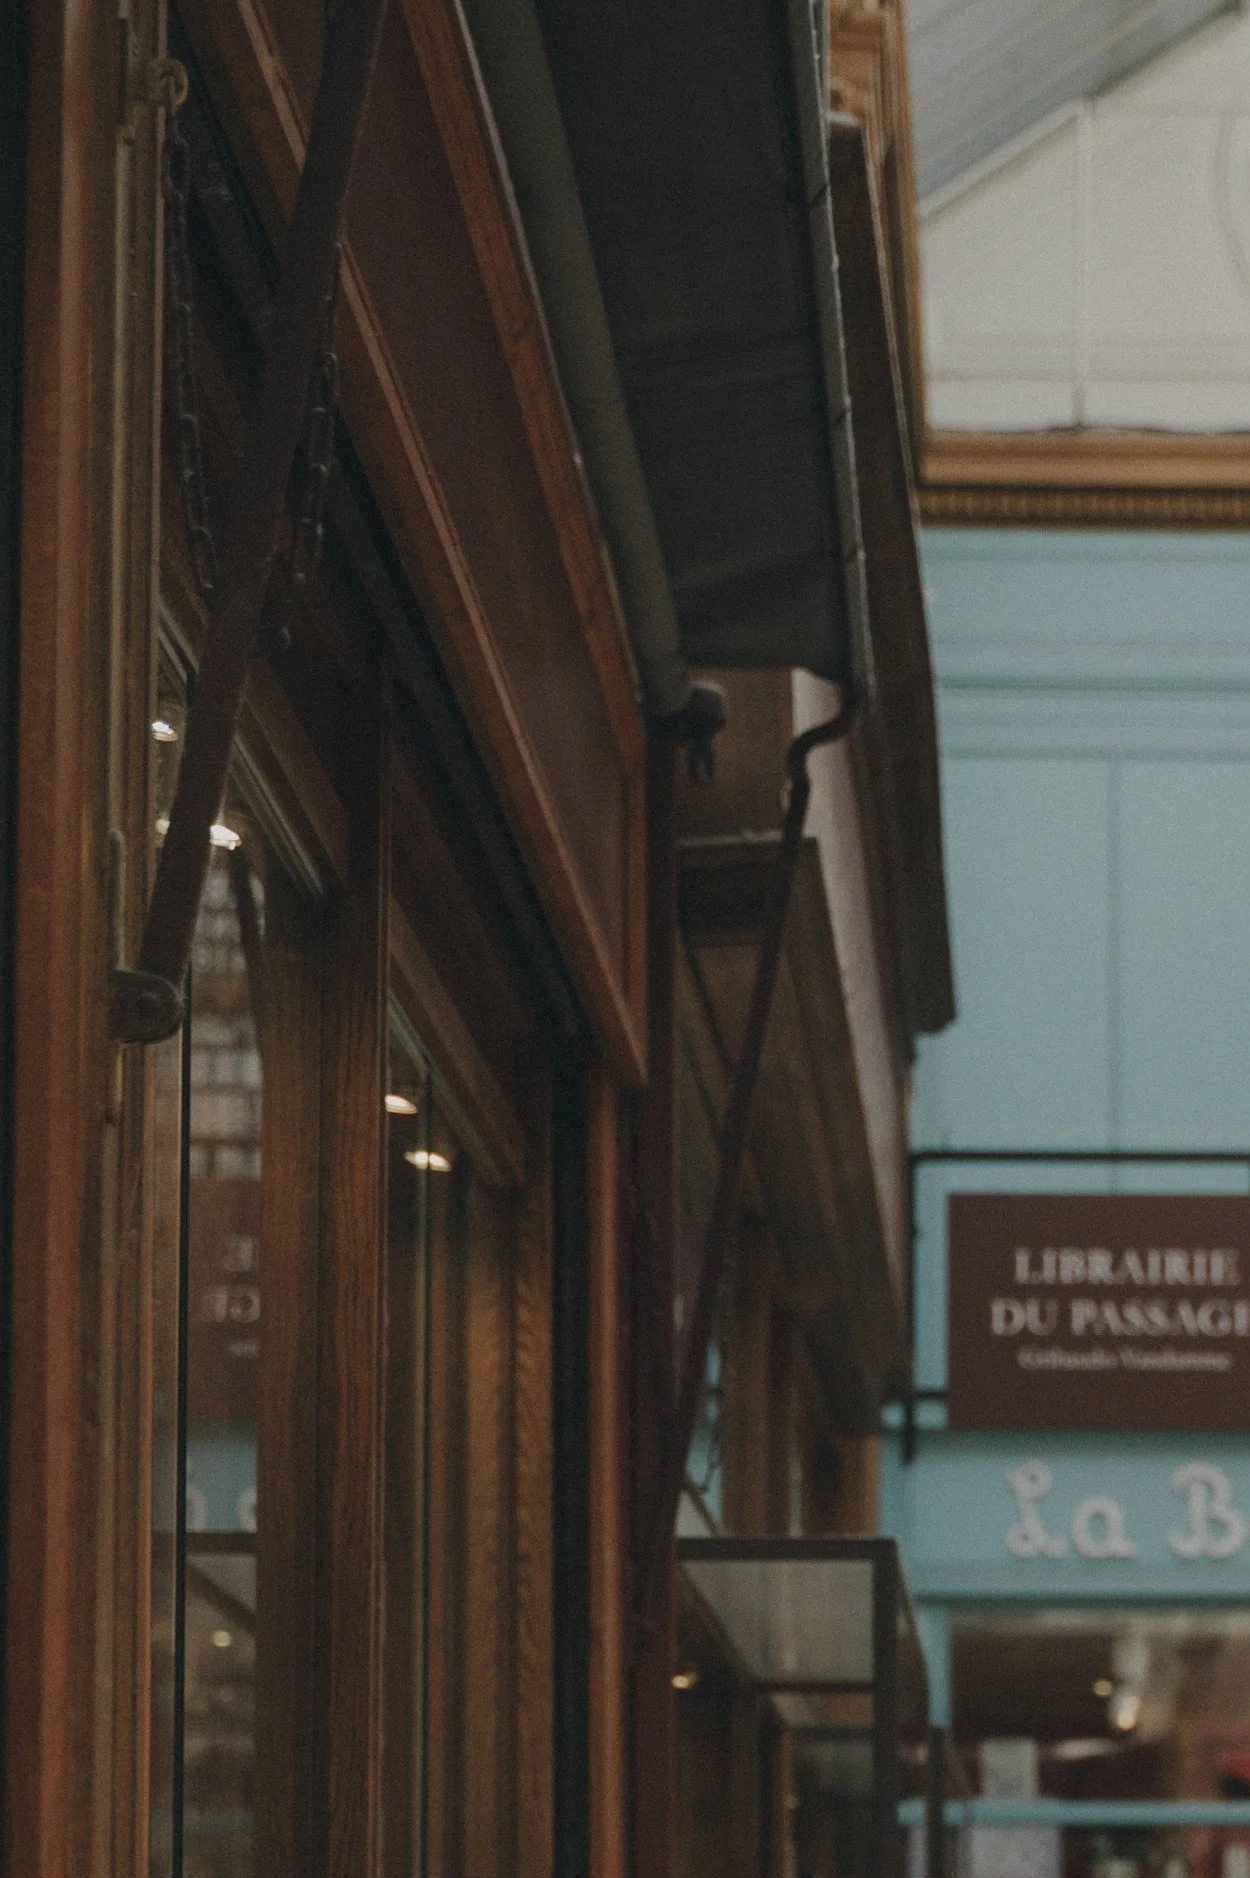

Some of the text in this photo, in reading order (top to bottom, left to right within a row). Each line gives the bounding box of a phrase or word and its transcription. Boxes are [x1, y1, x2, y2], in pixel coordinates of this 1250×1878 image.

[1013, 1246, 1241, 1287] LIBRAIRIE
[990, 1298, 1059, 1336] DU
[1005, 1460, 1137, 1560] La
